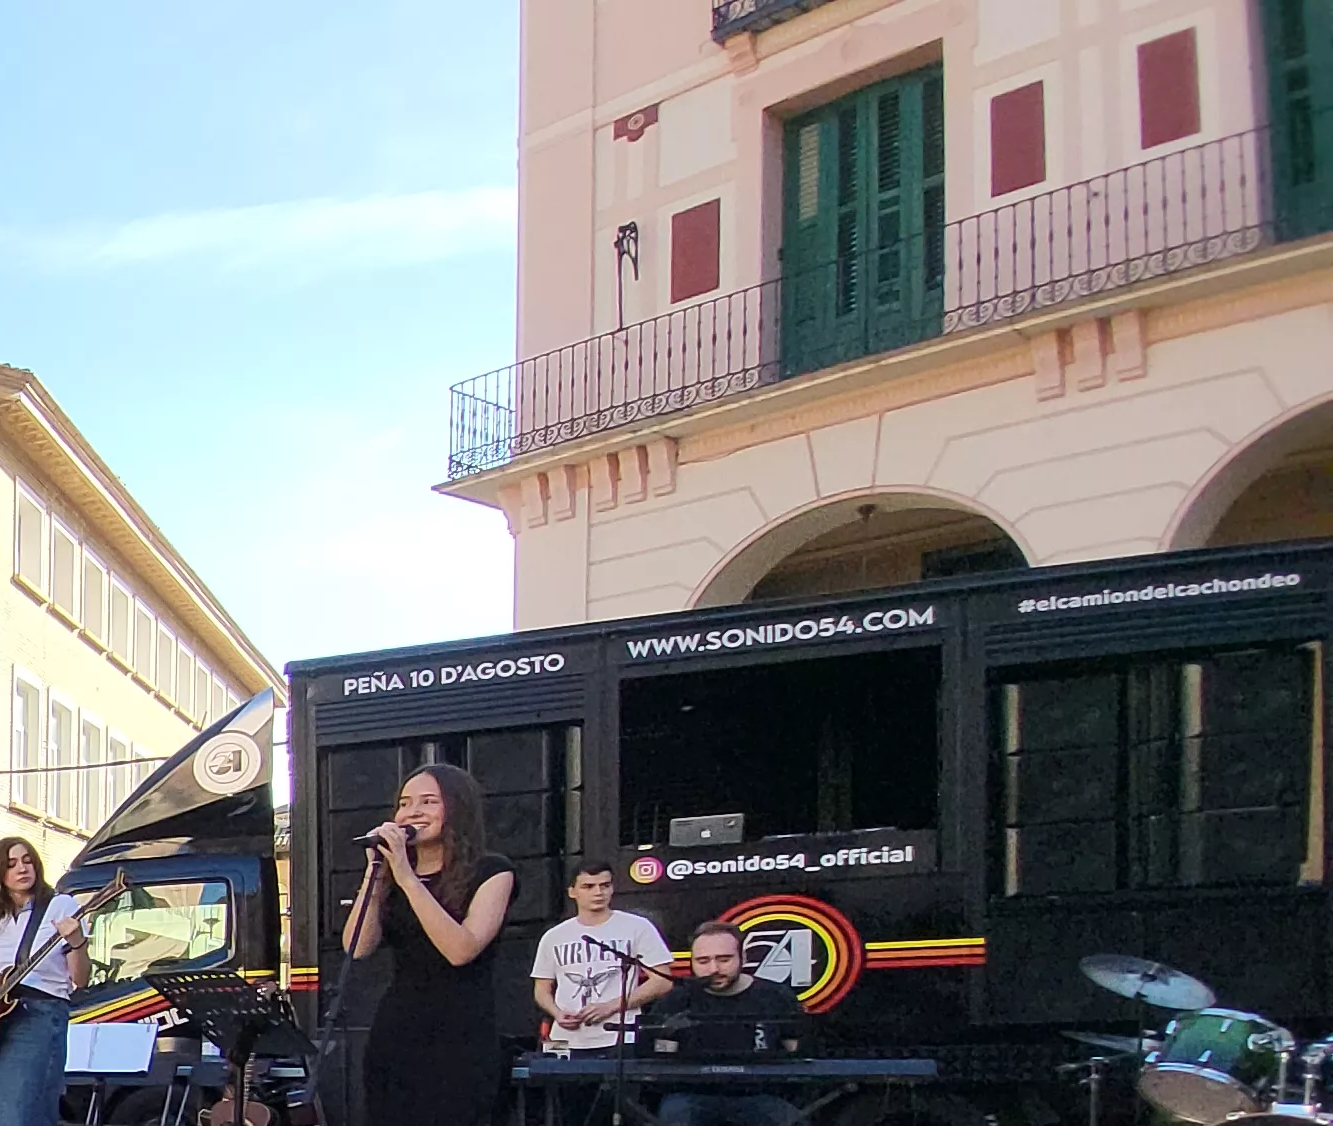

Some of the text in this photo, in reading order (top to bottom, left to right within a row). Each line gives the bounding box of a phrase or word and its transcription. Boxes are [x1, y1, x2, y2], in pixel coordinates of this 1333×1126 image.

[1017, 572, 1301, 613] #elcamiondelcachondeo
[626, 605, 933, 659] WWW.SONIDO54.COM
[343, 653, 565, 696] PEÑA 10 D'AGOSTO
[666, 845, 914, 881] @sonido54_official
